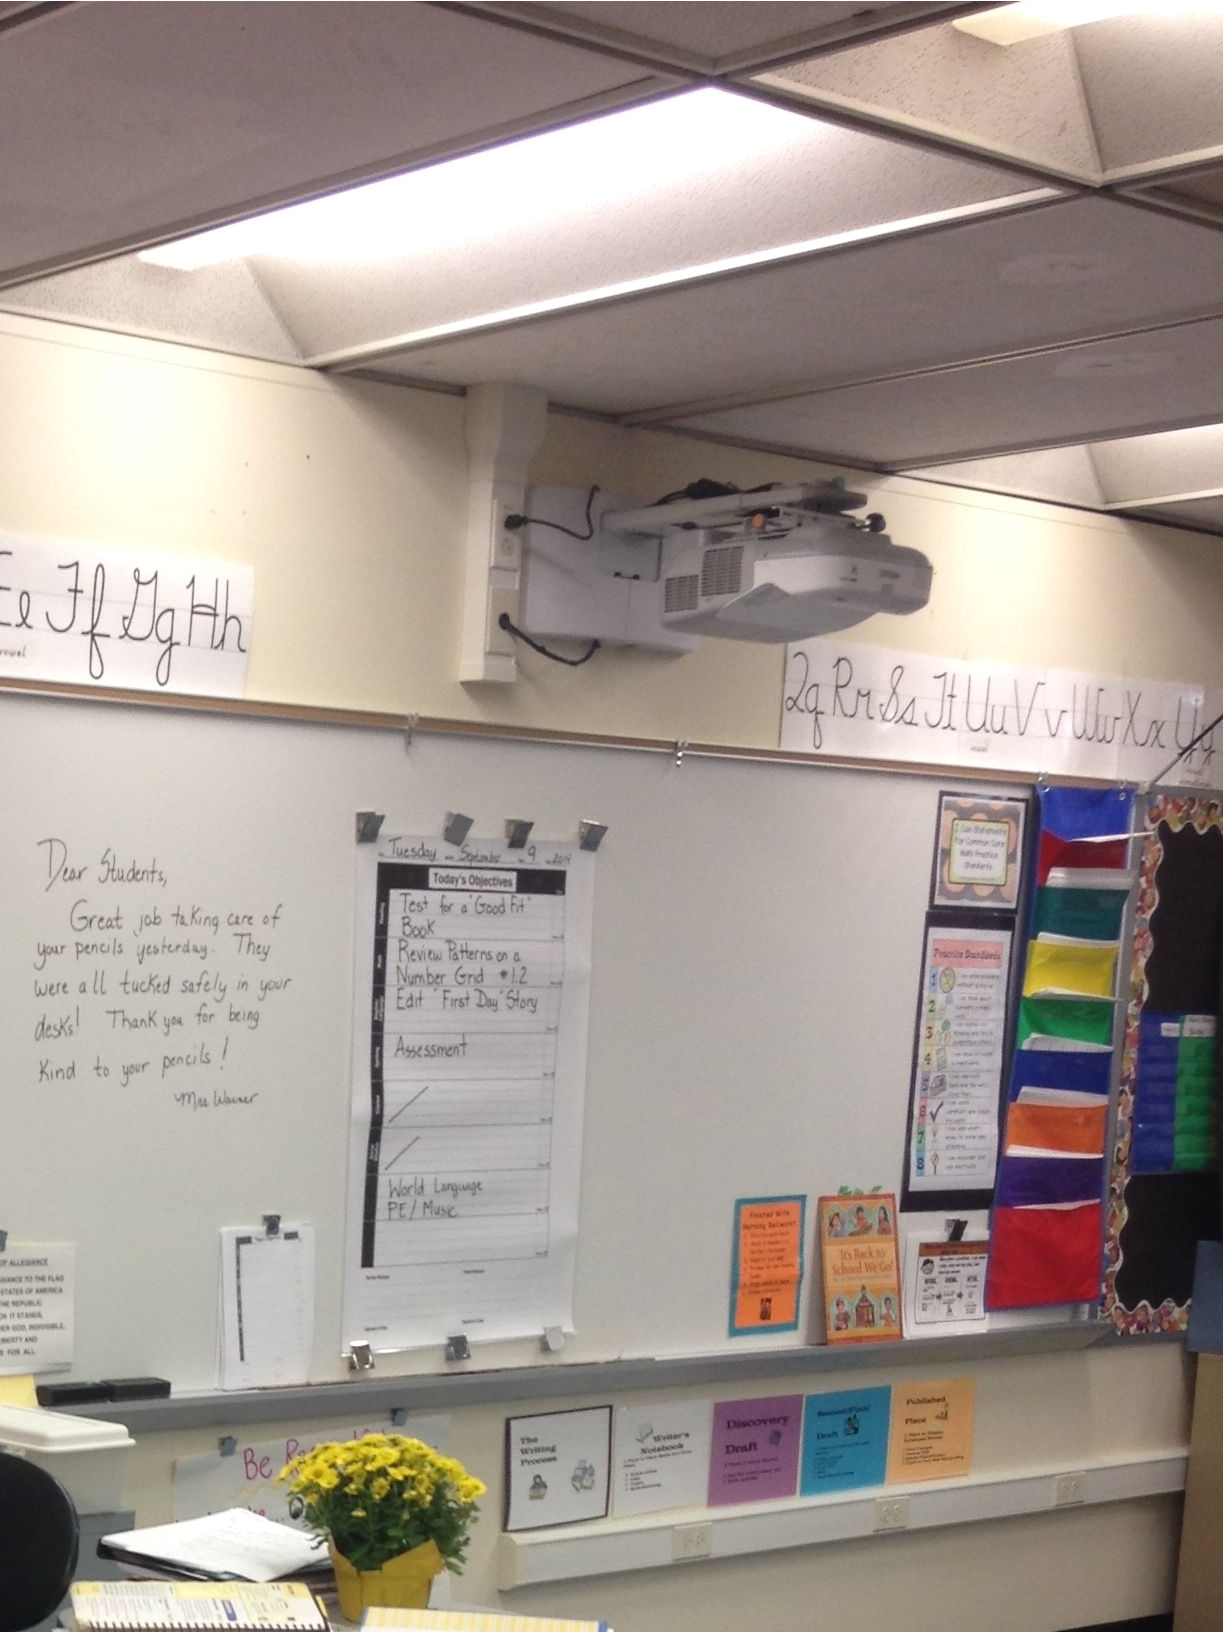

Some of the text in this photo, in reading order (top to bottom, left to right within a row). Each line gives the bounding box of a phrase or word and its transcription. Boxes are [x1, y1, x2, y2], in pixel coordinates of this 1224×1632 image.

[388, 836, 437, 862] Tuesday
[527, 845, 537, 862] 9
[37, 837, 167, 891] Dear Students,
[433, 872, 513, 888] Today's Objectives
[400, 892, 429, 913] Test
[440, 895, 452, 913] for
[460, 905, 468, 914] a
[70, 898, 124, 932] Great
[132, 906, 162, 937] job
[227, 913, 254, 926] care
[262, 903, 283, 928] of
[34, 940, 66, 972] your
[75, 937, 124, 960] pencils
[233, 932, 271, 962] They
[397, 938, 522, 963] Review Patterns on a
[34, 978, 68, 997] were
[180, 970, 227, 1003] safely
[237, 977, 248, 992] in
[259, 977, 292, 1001] your
[396, 964, 445, 985] Number
[454, 966, 484, 985] Grid
[396, 988, 424, 1011] Edit
[506, 988, 538, 1014] Story
[163, 1015, 184, 1037] you
[195, 1002, 216, 1024] for
[228, 1001, 261, 1031] being
[394, 1032, 468, 1058] Assessment
[93, 1055, 110, 1078] to
[120, 1060, 151, 1088] your
[388, 1176, 484, 1199] World Language
[422, 1199, 458, 1219] Music
[726, 1415, 791, 1431] Discovery
[520, 1436, 538, 1445] The
[520, 1444, 557, 1456] Writing
[725, 1440, 758, 1456] Draft
[242, 1447, 273, 1481] Be
[520, 1455, 558, 1467] Process
